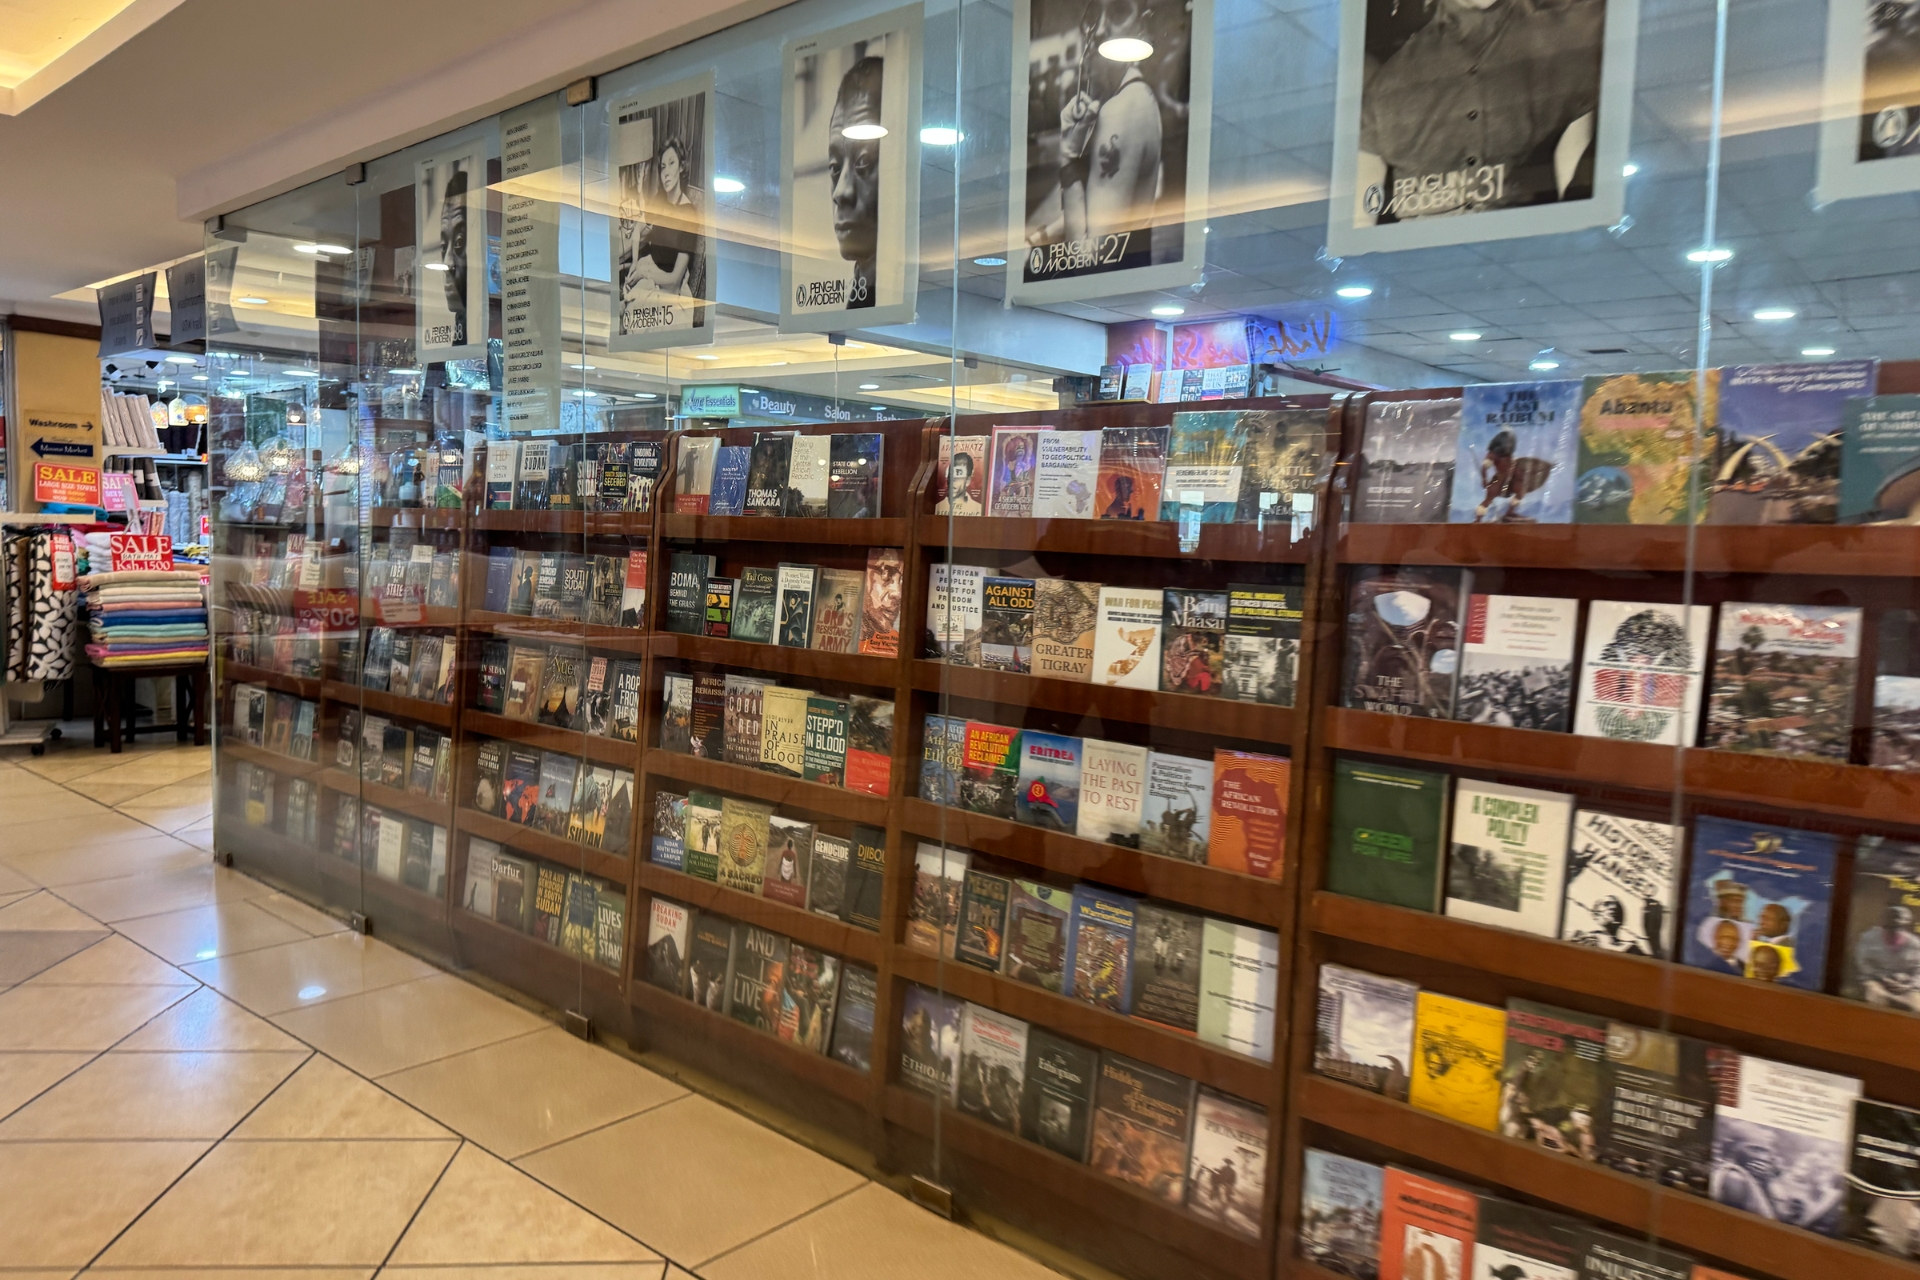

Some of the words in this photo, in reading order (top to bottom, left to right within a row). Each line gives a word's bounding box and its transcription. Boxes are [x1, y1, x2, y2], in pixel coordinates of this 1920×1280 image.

[1394, 172, 1468, 194] PENGUIN
[1383, 187, 1467, 215] MODERN
[1049, 239, 1100, 257] PENGUIN
[1043, 254, 1099, 274] MODERN
[810, 279, 845, 294] PENGUIN
[805, 291, 845, 306] MODERN
[632, 306, 660, 318] PENGUIN
[629, 316, 659, 330] MODERN
[760, 396, 796, 416] Beauty
[824, 405, 851, 421] Salon
[1600, 398, 1673, 416] Abantu
[29, 418, 78, 430] Washroom
[960, 442, 983, 451] SHATZ
[1042, 446, 1088, 454] VULNERABILITY
[524, 456, 547, 470] SUDAN
[634, 458, 658, 467] REVOLUTION
[39, 466, 96, 485] SALE
[39, 480, 60, 489] LARGE
[60, 482, 75, 490] SIZE
[76, 483, 97, 492] TOWEL
[748, 488, 777, 498] THOMAS
[746, 497, 781, 507] SANKARA
[110, 536, 171, 555] SALE
[116, 560, 171, 571] Ksh.1500
[670, 571, 698, 588] BOMA
[757, 574, 773, 583] Grass
[669, 589, 688, 598] BEHIND
[962, 587, 976, 595] FOR
[985, 585, 1034, 596] AGAINST
[669, 599, 678, 607] THE
[678, 599, 696, 609] GRASS
[988, 597, 1008, 607] ALL
[1105, 597, 1124, 607] WAR
[1125, 598, 1141, 608] FOR
[1183, 595, 1226, 618] Being
[818, 608, 854, 628] LORD'S
[1171, 610, 1225, 630] Maasai
[816, 624, 852, 638] RESISTANCE
[818, 635, 852, 653] ARMY
[1036, 643, 1093, 660] GREATER
[481, 664, 487, 672] IN
[488, 665, 506, 675] SUDAN
[554, 655, 577, 675] Nuer
[1041, 659, 1087, 674] TIGRAY
[618, 674, 624, 687] A
[1376, 675, 1404, 688] THE
[614, 705, 629, 719] THE
[738, 718, 759, 736] RED
[765, 719, 778, 731] IN
[806, 714, 844, 736] STEPP'D
[764, 729, 807, 745] PRAISE
[805, 731, 814, 748] IN
[815, 733, 846, 754] BLOOD
[970, 729, 979, 739] AN
[980, 730, 1010, 744] AFRICAN
[766, 740, 779, 751] OF
[969, 739, 1010, 756] REVOLUTION
[1029, 745, 1074, 761] ERITREA
[764, 749, 804, 765] BLOOD
[968, 750, 1006, 765] RECLAIMED
[1088, 756, 1137, 777] LAYING
[1151, 761, 1192, 774] Pastoralism
[1158, 769, 1183, 780] Politics
[1083, 772, 1107, 789] THE
[1111, 777, 1142, 795] PAST
[1151, 775, 1185, 787] Northern
[1185, 781, 1206, 791] Kenya
[1157, 783, 1190, 794] Southern
[1222, 780, 1241, 790] THE
[1084, 789, 1100, 805] TO
[1106, 794, 1139, 813] REST
[1149, 789, 1178, 800] Ethiopia
[1222, 791, 1261, 803] AFRICAN
[1221, 800, 1279, 816] REVOLUTION
[1471, 795, 1482, 815] A
[1482, 796, 1541, 824] COMPLEX
[569, 825, 602, 848] SUDAN
[815, 839, 849, 860] GENOCIDE
[492, 859, 521, 878] Darfur
[551, 871, 565, 883] AND
[727, 869, 763, 885] SACRED
[538, 878, 564, 893] GENOCIDE
[726, 881, 755, 894] CAUSE
[544, 889, 562, 902] SOUTH
[535, 897, 561, 917] SUDAN
[652, 902, 683, 921] BREAKING
[598, 906, 622, 928] LIVES
[656, 913, 677, 929] SUDAN
[1080, 905, 1133, 927] Warriorhood
[598, 923, 609, 940] AT
[746, 928, 775, 957] AND
[733, 977, 762, 1012] LIVE
